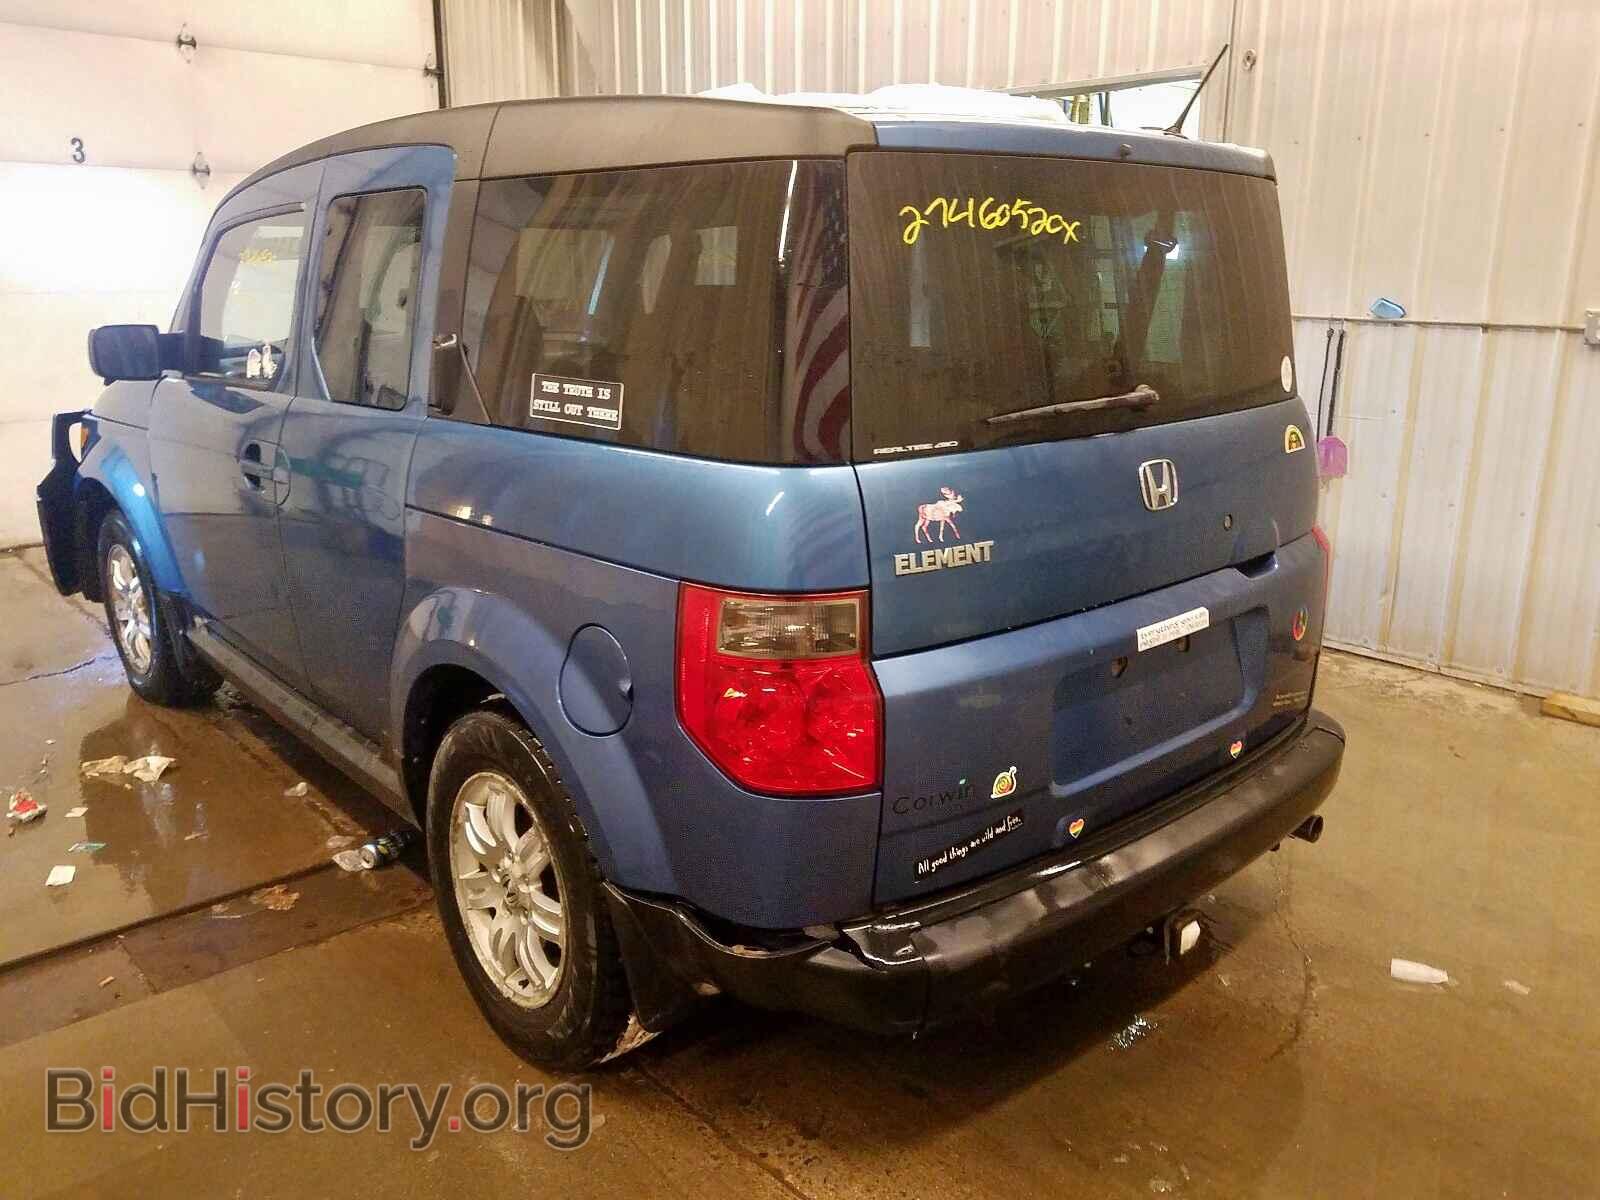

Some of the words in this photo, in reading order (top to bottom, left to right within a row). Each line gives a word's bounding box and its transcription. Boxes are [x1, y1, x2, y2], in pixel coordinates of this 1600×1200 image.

[71, 137, 85, 164] 3
[541, 381, 560, 394] THE
[562, 383, 594, 398] TRUTH
[597, 387, 611, 400] IS
[533, 399, 561, 413] STILL
[564, 403, 584, 416] OUT
[586, 406, 619, 422] THERE
[894, 540, 994, 576] ELEMENT
[917, 859, 930, 875] All
[931, 851, 948, 873] good
[949, 846, 969, 858] things
[981, 826, 994, 844] wild
[994, 819, 1006, 834] and
